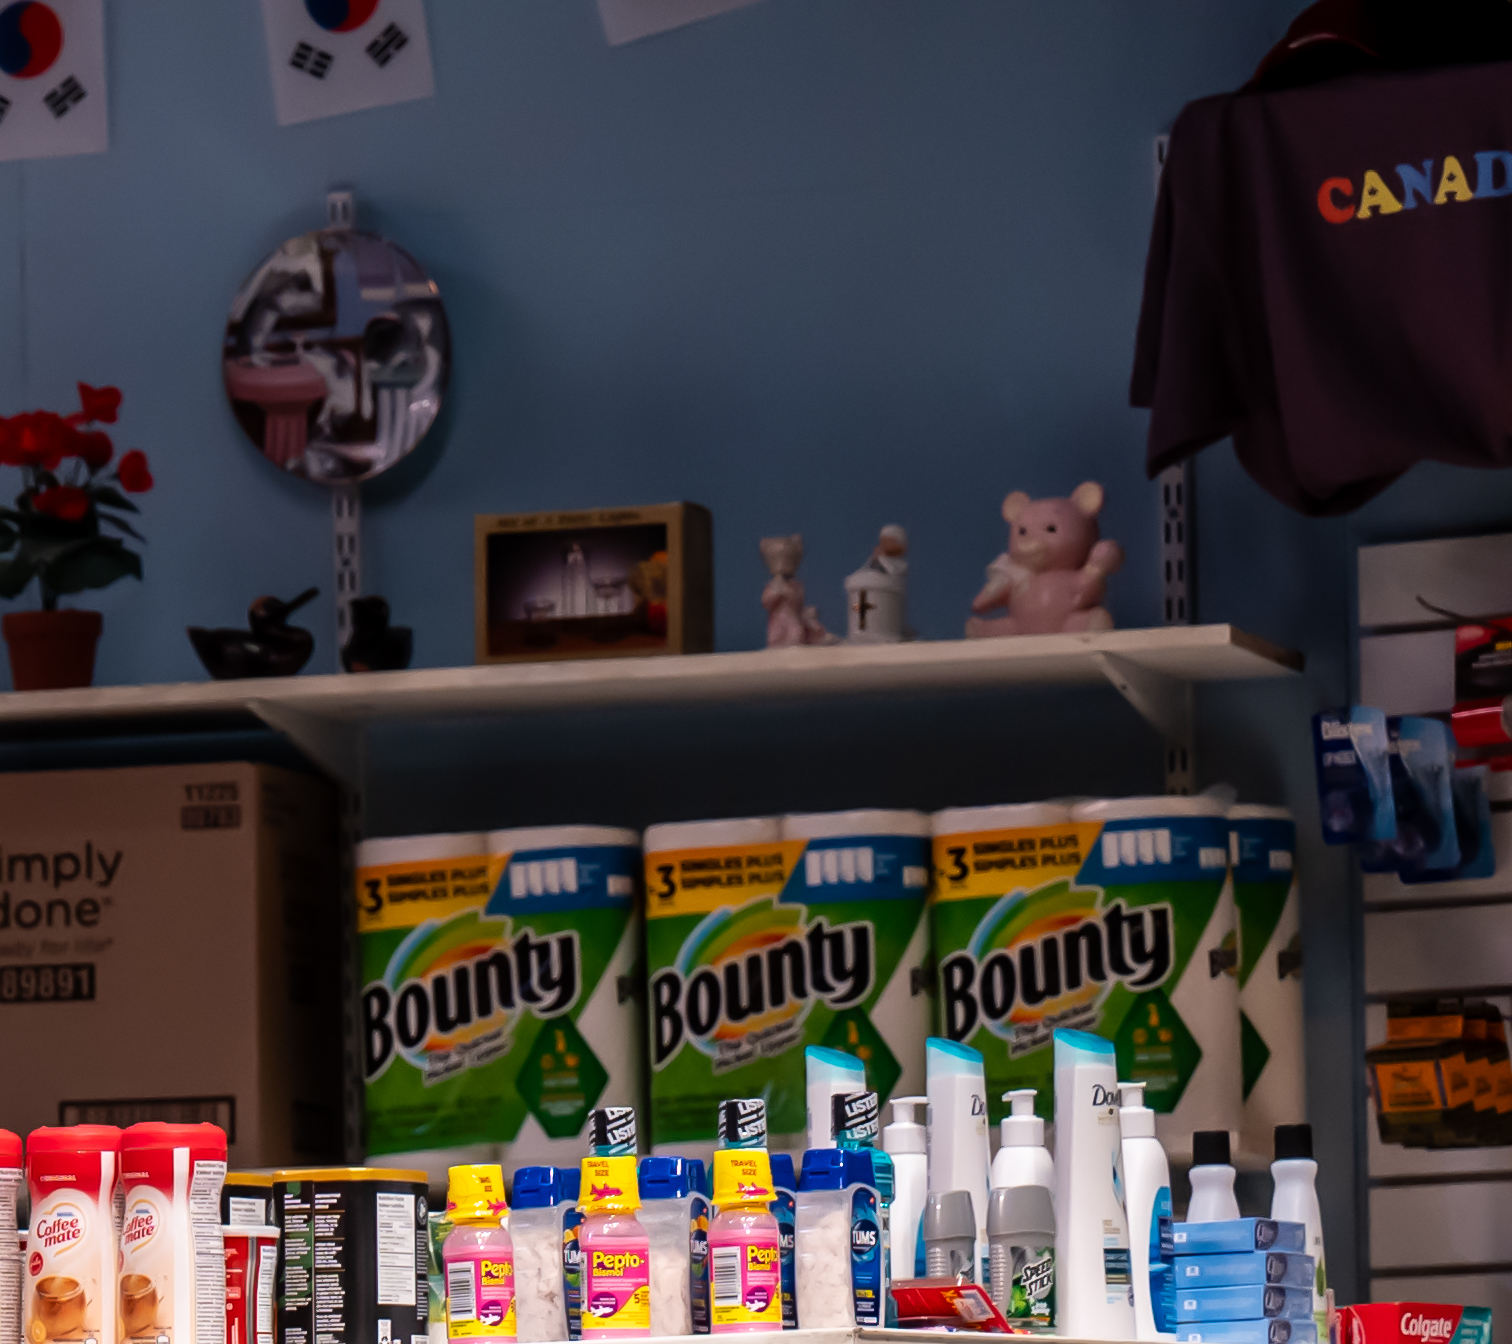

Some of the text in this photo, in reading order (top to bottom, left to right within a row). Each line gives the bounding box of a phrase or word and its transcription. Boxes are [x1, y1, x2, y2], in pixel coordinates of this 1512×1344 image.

[973, 834, 1079, 857] SINGLES PLUS
[680, 851, 783, 873] SINGLES PLUS
[947, 845, 970, 881] 3
[1040, 852, 1082, 870] PLUS
[388, 864, 488, 886] SINGLES PLUS
[657, 864, 676, 900] 3
[746, 868, 784, 886] PLUS
[364, 877, 383, 915] 3
[446, 880, 490, 898] PLUS
[0, 965, 94, 1000] 89891
[943, 901, 1171, 1044] Bounty
[364, 929, 578, 1079] Bounty
[653, 921, 872, 1068] Bounty
[36, 1216, 79, 1239] Coffee
[44, 1227, 81, 1248] mate
[852, 1230, 877, 1246] TUMS
[779, 1235, 794, 1249] MS
[591, 1251, 646, 1270] Pepto-
[591, 1267, 624, 1278] Bismol
[1400, 1312, 1453, 1341] Colgate
